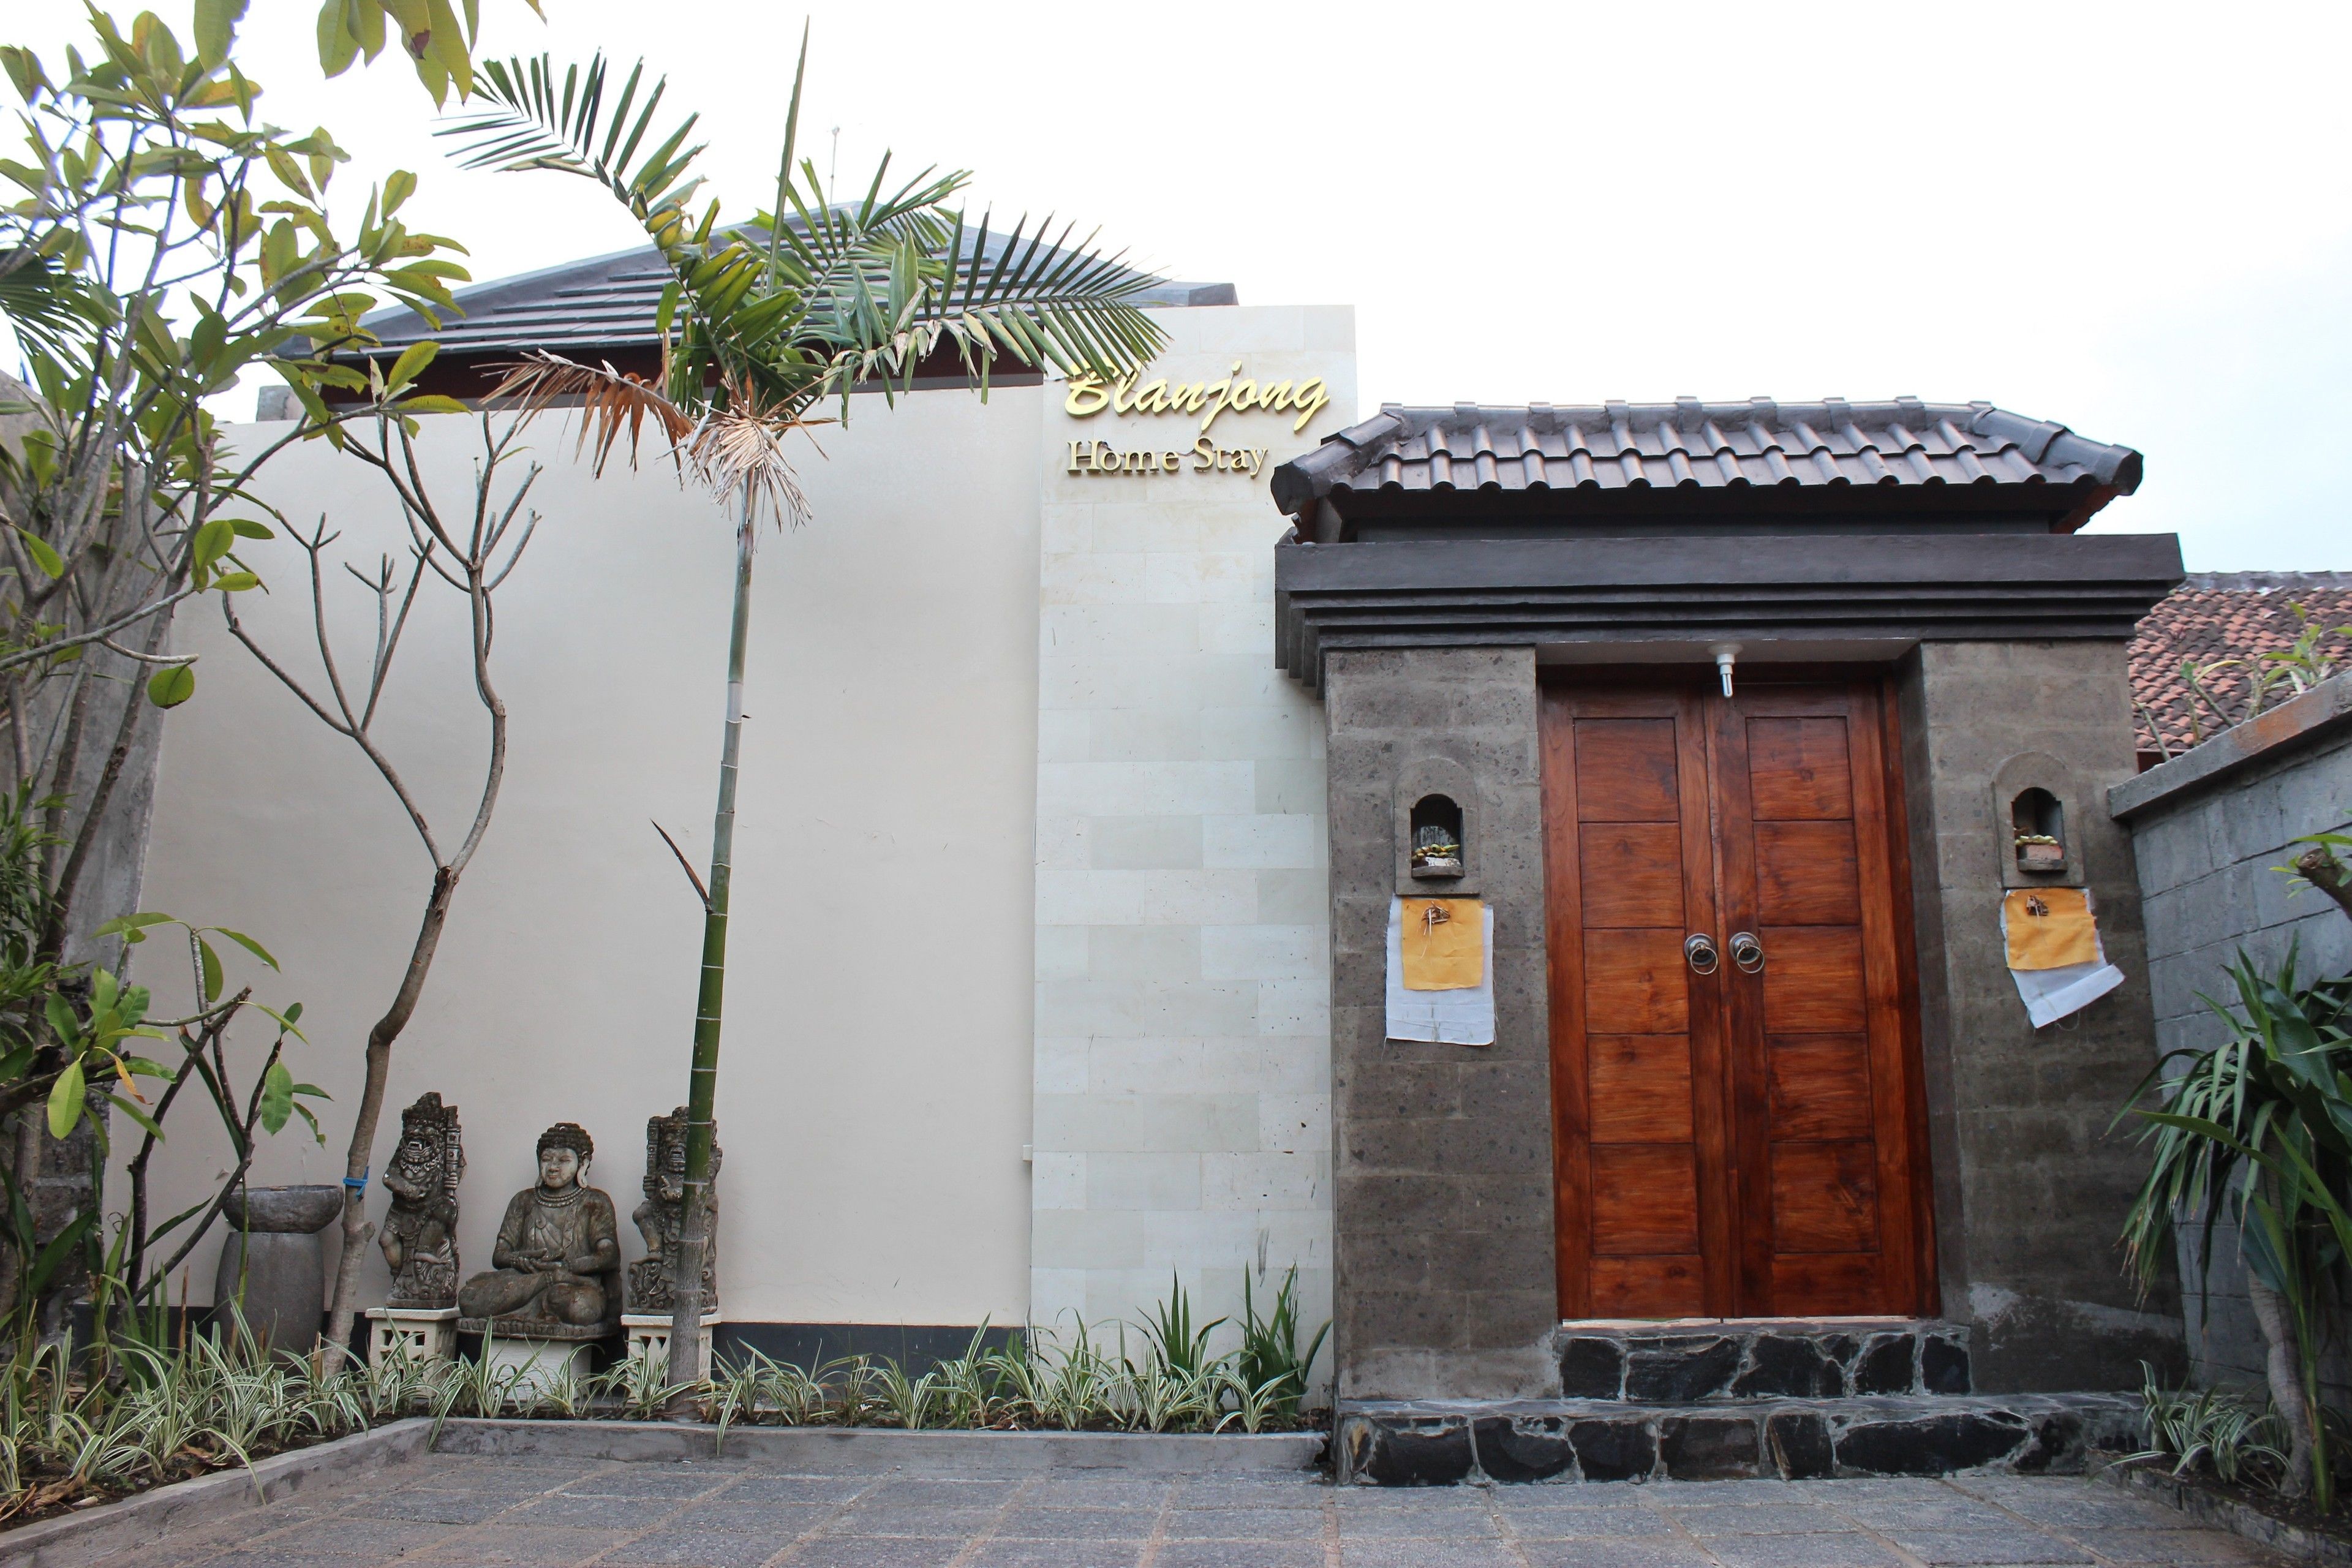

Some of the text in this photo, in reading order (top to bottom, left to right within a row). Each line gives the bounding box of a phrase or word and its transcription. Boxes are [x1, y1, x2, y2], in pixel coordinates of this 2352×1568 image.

[1065, 356, 1330, 433] Blanjong
[1068, 437, 1268, 478] Home Stay
